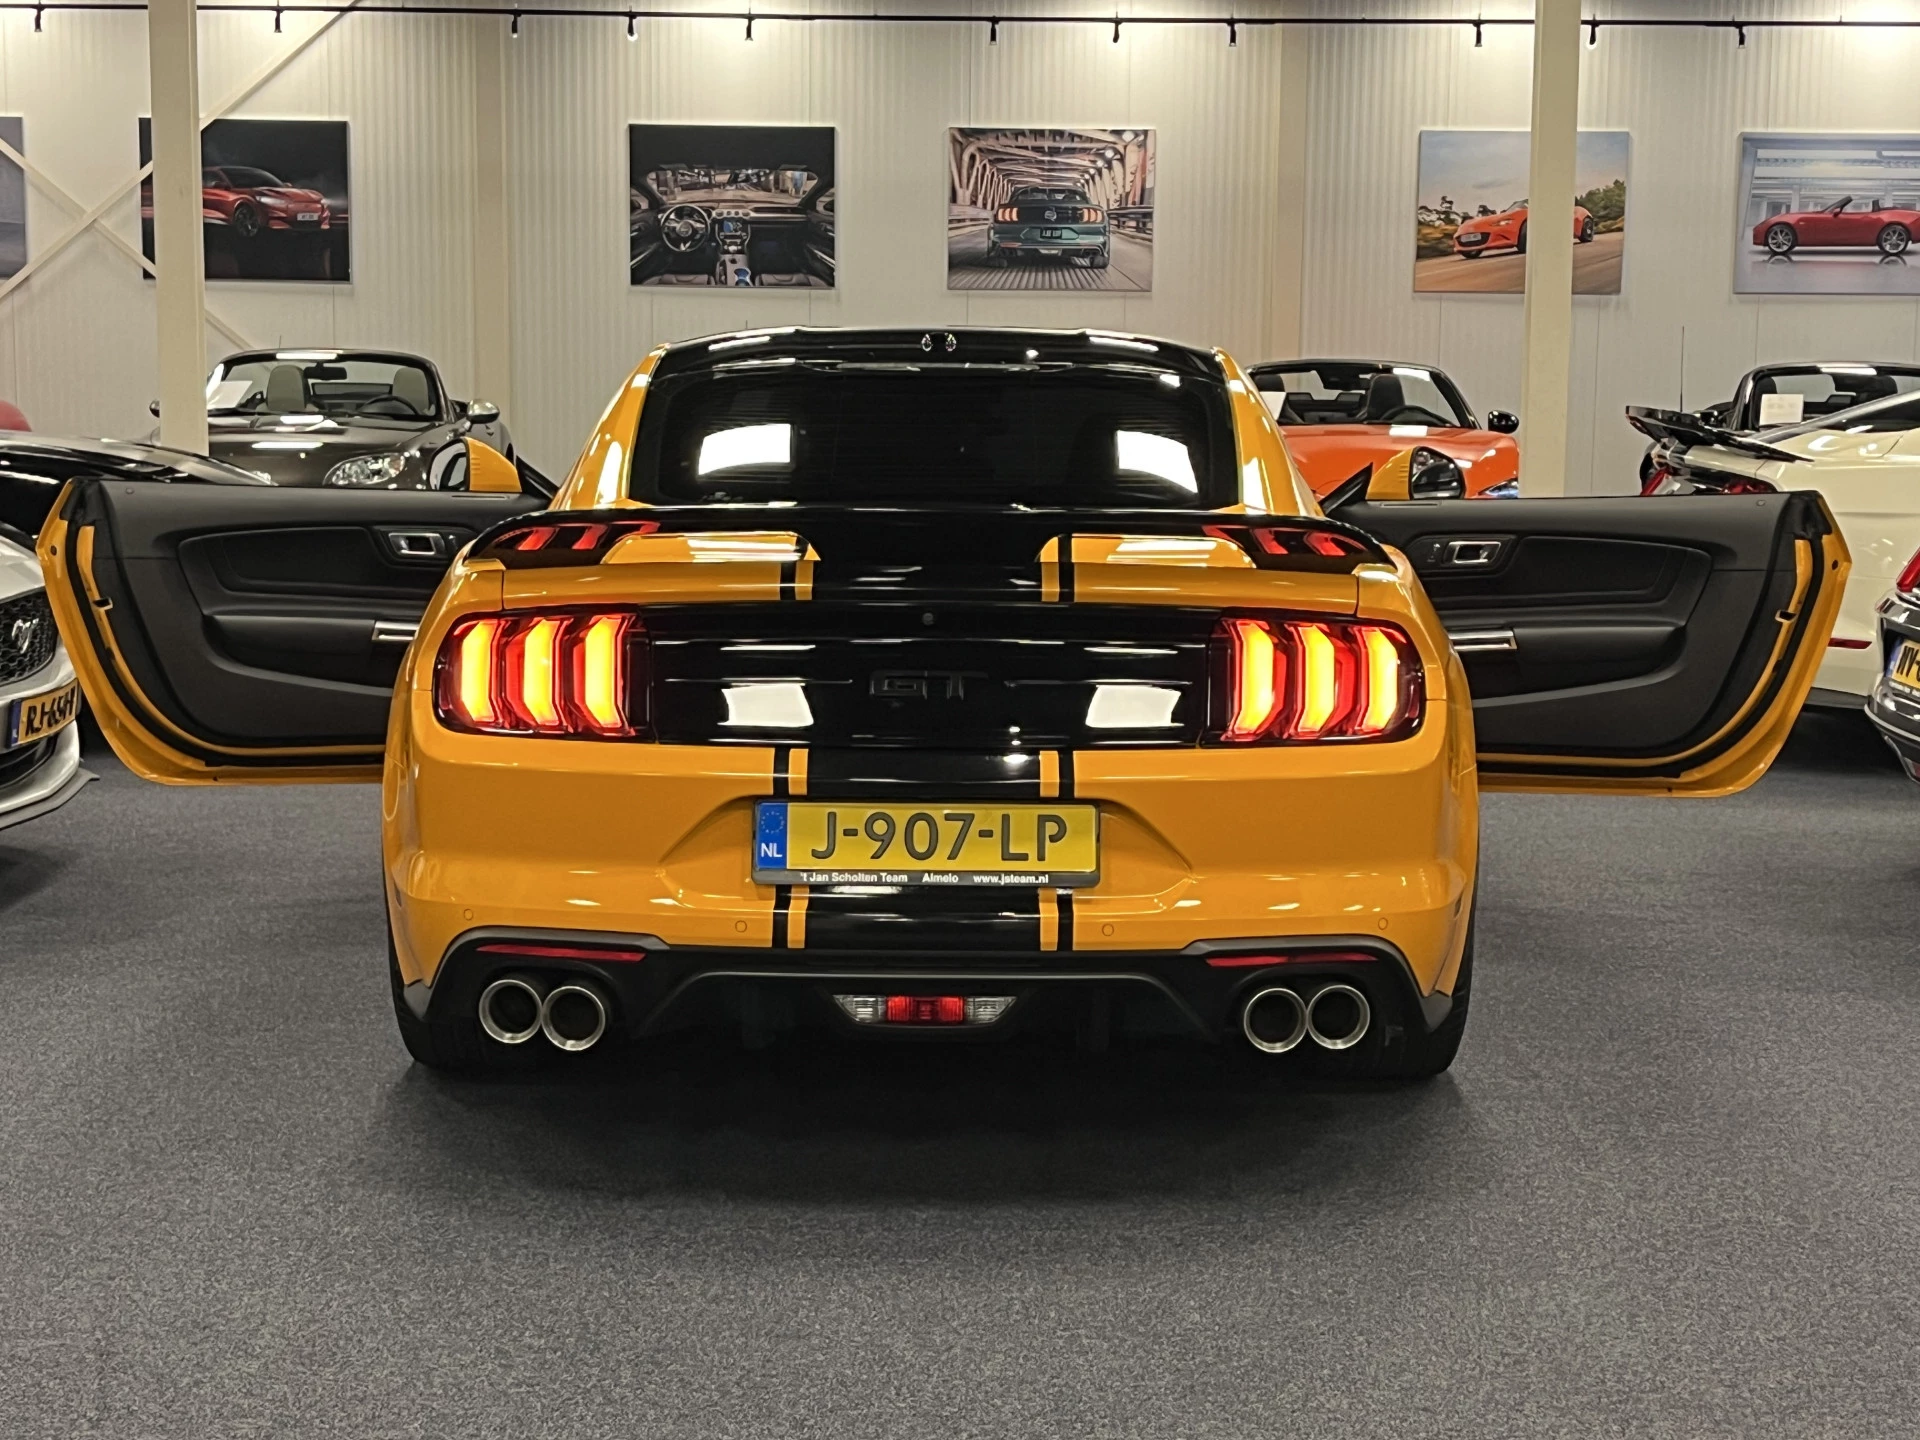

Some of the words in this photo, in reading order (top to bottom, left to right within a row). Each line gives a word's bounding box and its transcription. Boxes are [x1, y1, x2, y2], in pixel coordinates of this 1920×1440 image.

[869, 670, 989, 700] GT
[810, 811, 1068, 862] J-907-LP
[760, 842, 783, 858] NL
[809, 872, 829, 882] Jan
[831, 872, 878, 882] Scholten
[880, 872, 908, 883] Team
[922, 873, 959, 883] Almelo
[973, 873, 1049, 886] www.jsteam.nl
